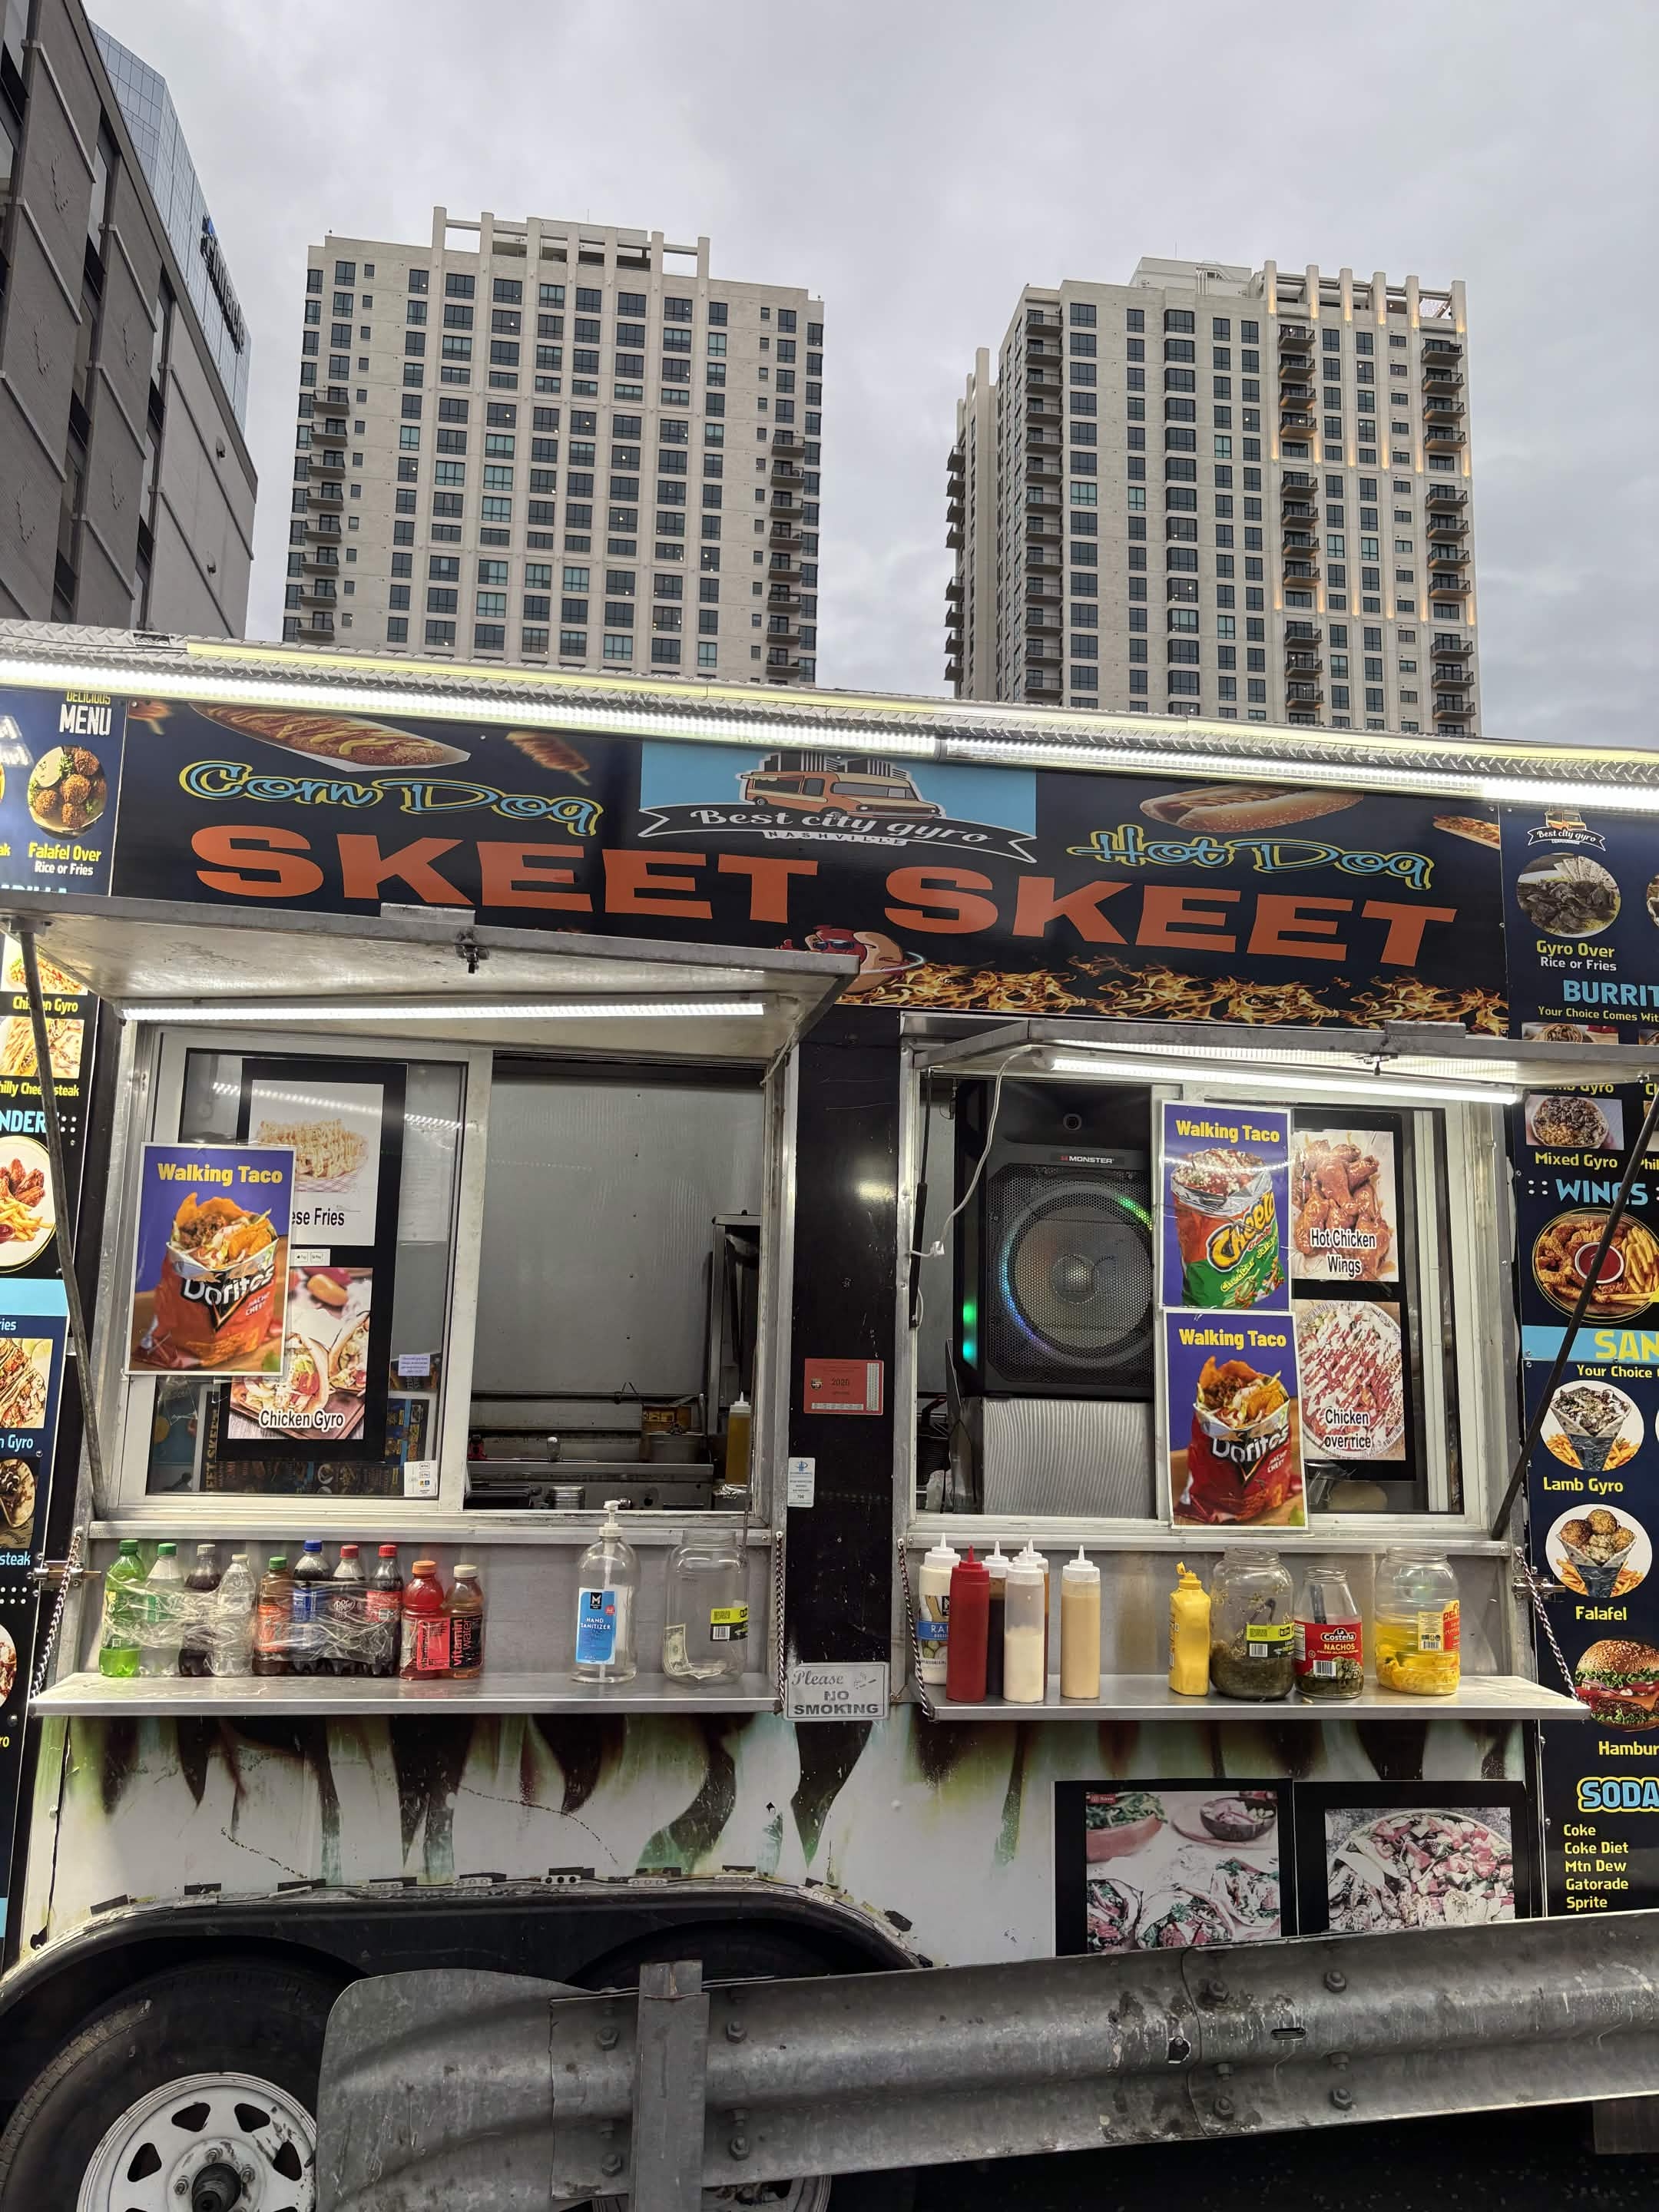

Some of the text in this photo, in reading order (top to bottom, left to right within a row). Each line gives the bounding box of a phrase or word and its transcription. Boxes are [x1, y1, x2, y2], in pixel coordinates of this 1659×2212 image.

[59, 704, 112, 736] MENU
[372, 777, 604, 838] Dog
[690, 809, 995, 844] Best city gyro
[1536, 829, 1558, 839] Best
[1575, 833, 1597, 843] gyro
[767, 830, 906, 846] NASHVILLE
[28, 843, 71, 860] Falafel
[72, 846, 101, 862] Over
[1065, 823, 1436, 891] Hot Dog
[35, 860, 94, 876] Rice or Fries
[190, 825, 1458, 968] SKEET SKEET
[1536, 940, 1615, 959] Gyro Over
[1540, 957, 1618, 972] Rice or Fries
[1563, 979, 1659, 1008] BURRIT
[12, 995, 79, 1015] Chien Gyro
[1538, 1005, 1563, 1018] Your
[1566, 1007, 1600, 1020] Choice
[1603, 1010, 1638, 1022] Comes
[0, 1110, 60, 1134] NDER
[1175, 1119, 1280, 1144] Walking Taco
[1068, 1155, 1113, 1164] MONSTER
[1535, 1151, 1580, 1167] Mixed
[1583, 1154, 1618, 1171] Gyro
[157, 1162, 283, 1187] Walking Taco
[313, 1207, 345, 1227] Fries
[1311, 1229, 1376, 1249] Hot Chicken
[1327, 1255, 1362, 1277] Wings
[184, 1265, 275, 1306] Doritos
[1179, 1328, 1287, 1350] Walking Taco
[1577, 1364, 1653, 1379] Your Choice
[260, 1410, 344, 1431] Chicken Gyro
[1325, 1408, 1369, 1425] Chicken
[8, 1434, 34, 1452] Gyro
[1212, 1424, 1290, 1463] Doritos
[1324, 1432, 1372, 1448] over rice
[1543, 1476, 1624, 1495] Lamb Gyro
[1576, 1605, 1628, 1621] Falafel
[452, 1619, 463, 1666] vitamin
[462, 1618, 472, 1651] water
[791, 1670, 844, 1686] Please
[823, 1690, 849, 1701] NO
[793, 1704, 879, 1715] SMOKING
[1598, 1740, 1659, 1756] Hambur
[1580, 1779, 1659, 1810] SODA
[1563, 1823, 1597, 1836] Coke
[1565, 1841, 1629, 1854] Coke Diet
[1565, 1859, 1627, 1873] Mtn Dew
[1566, 1877, 1629, 1891] Gatorade
[1566, 1896, 1608, 1912] Sprite
